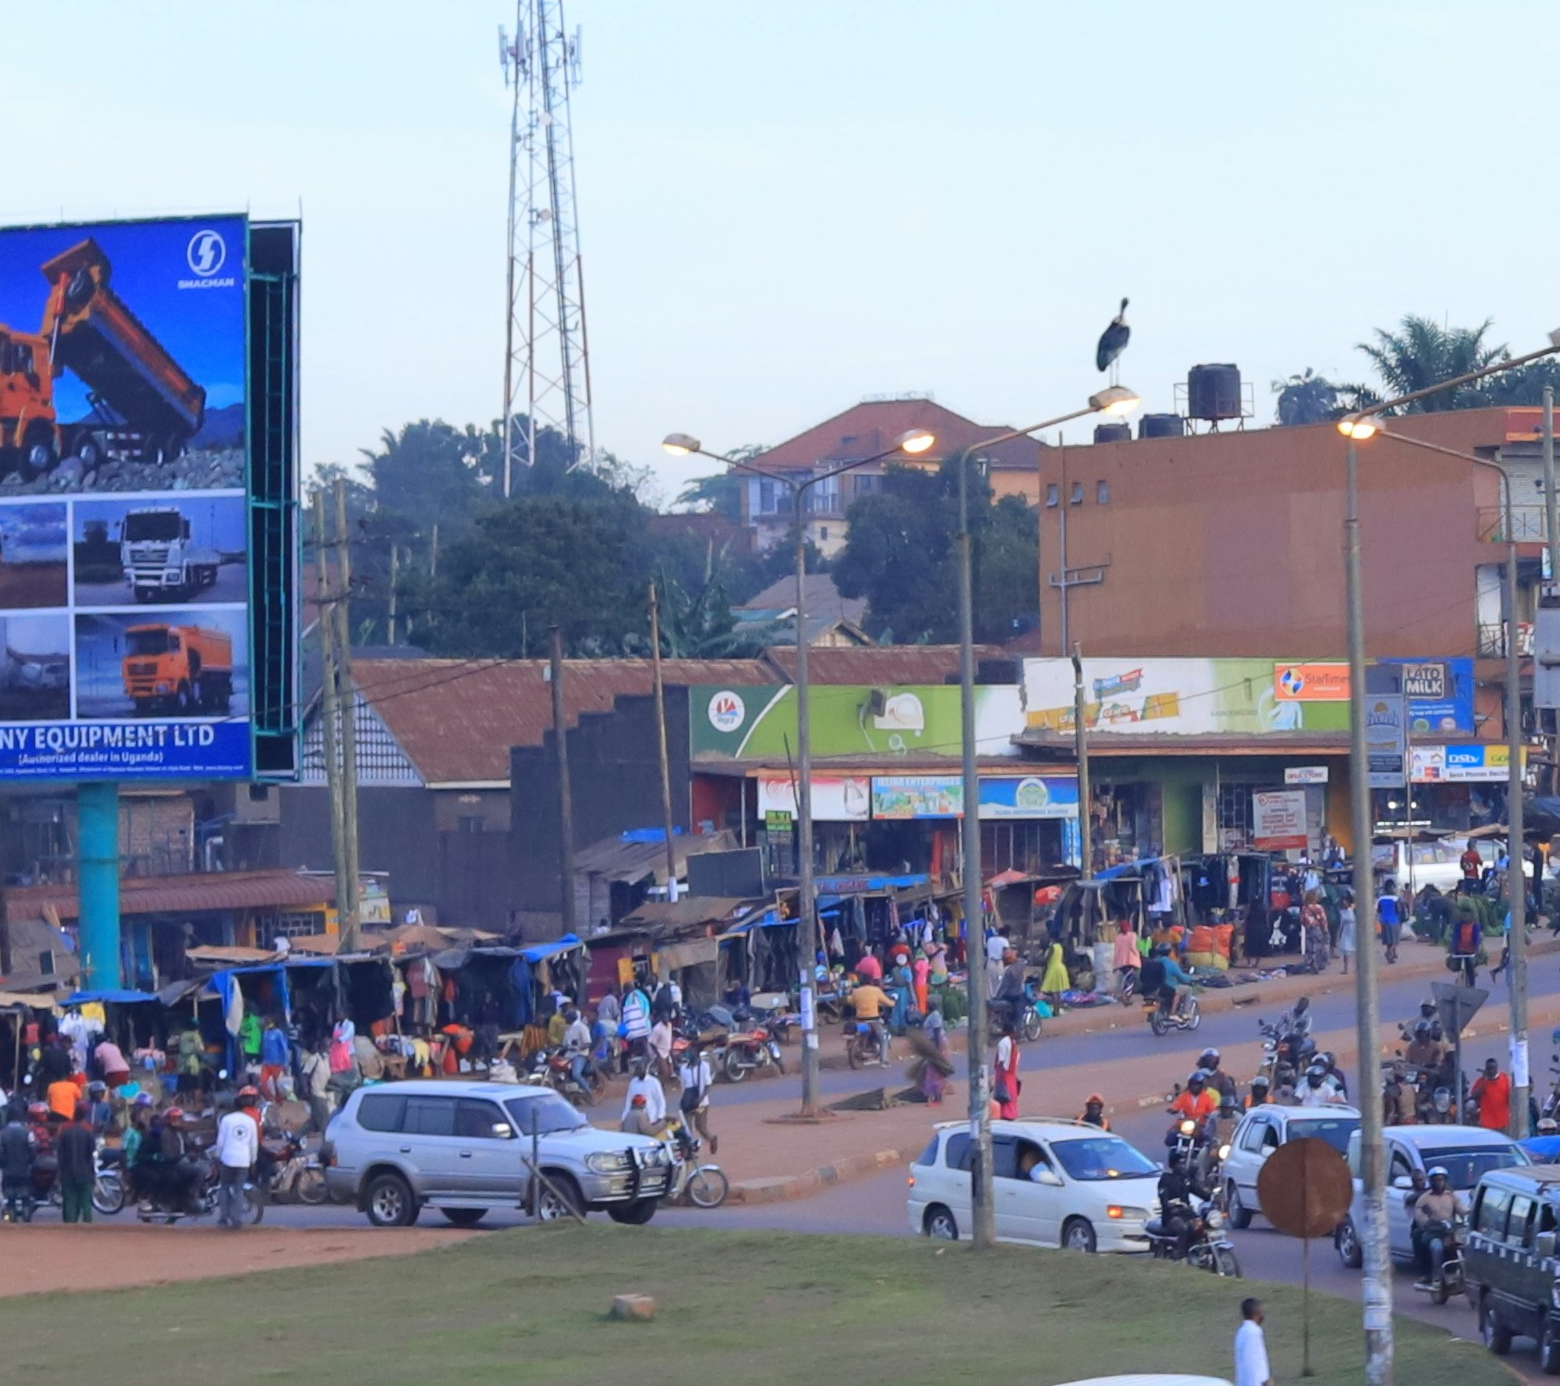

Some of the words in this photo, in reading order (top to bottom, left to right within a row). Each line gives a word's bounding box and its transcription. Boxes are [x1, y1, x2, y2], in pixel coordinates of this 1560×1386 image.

[1407, 668, 1439, 679] LATO
[34, 725, 168, 753] EQUIPMENT
[174, 724, 215, 746] LTD
[78, 751, 108, 763] dealer
[111, 751, 120, 762] in
[122, 750, 164, 765] Uganda)
